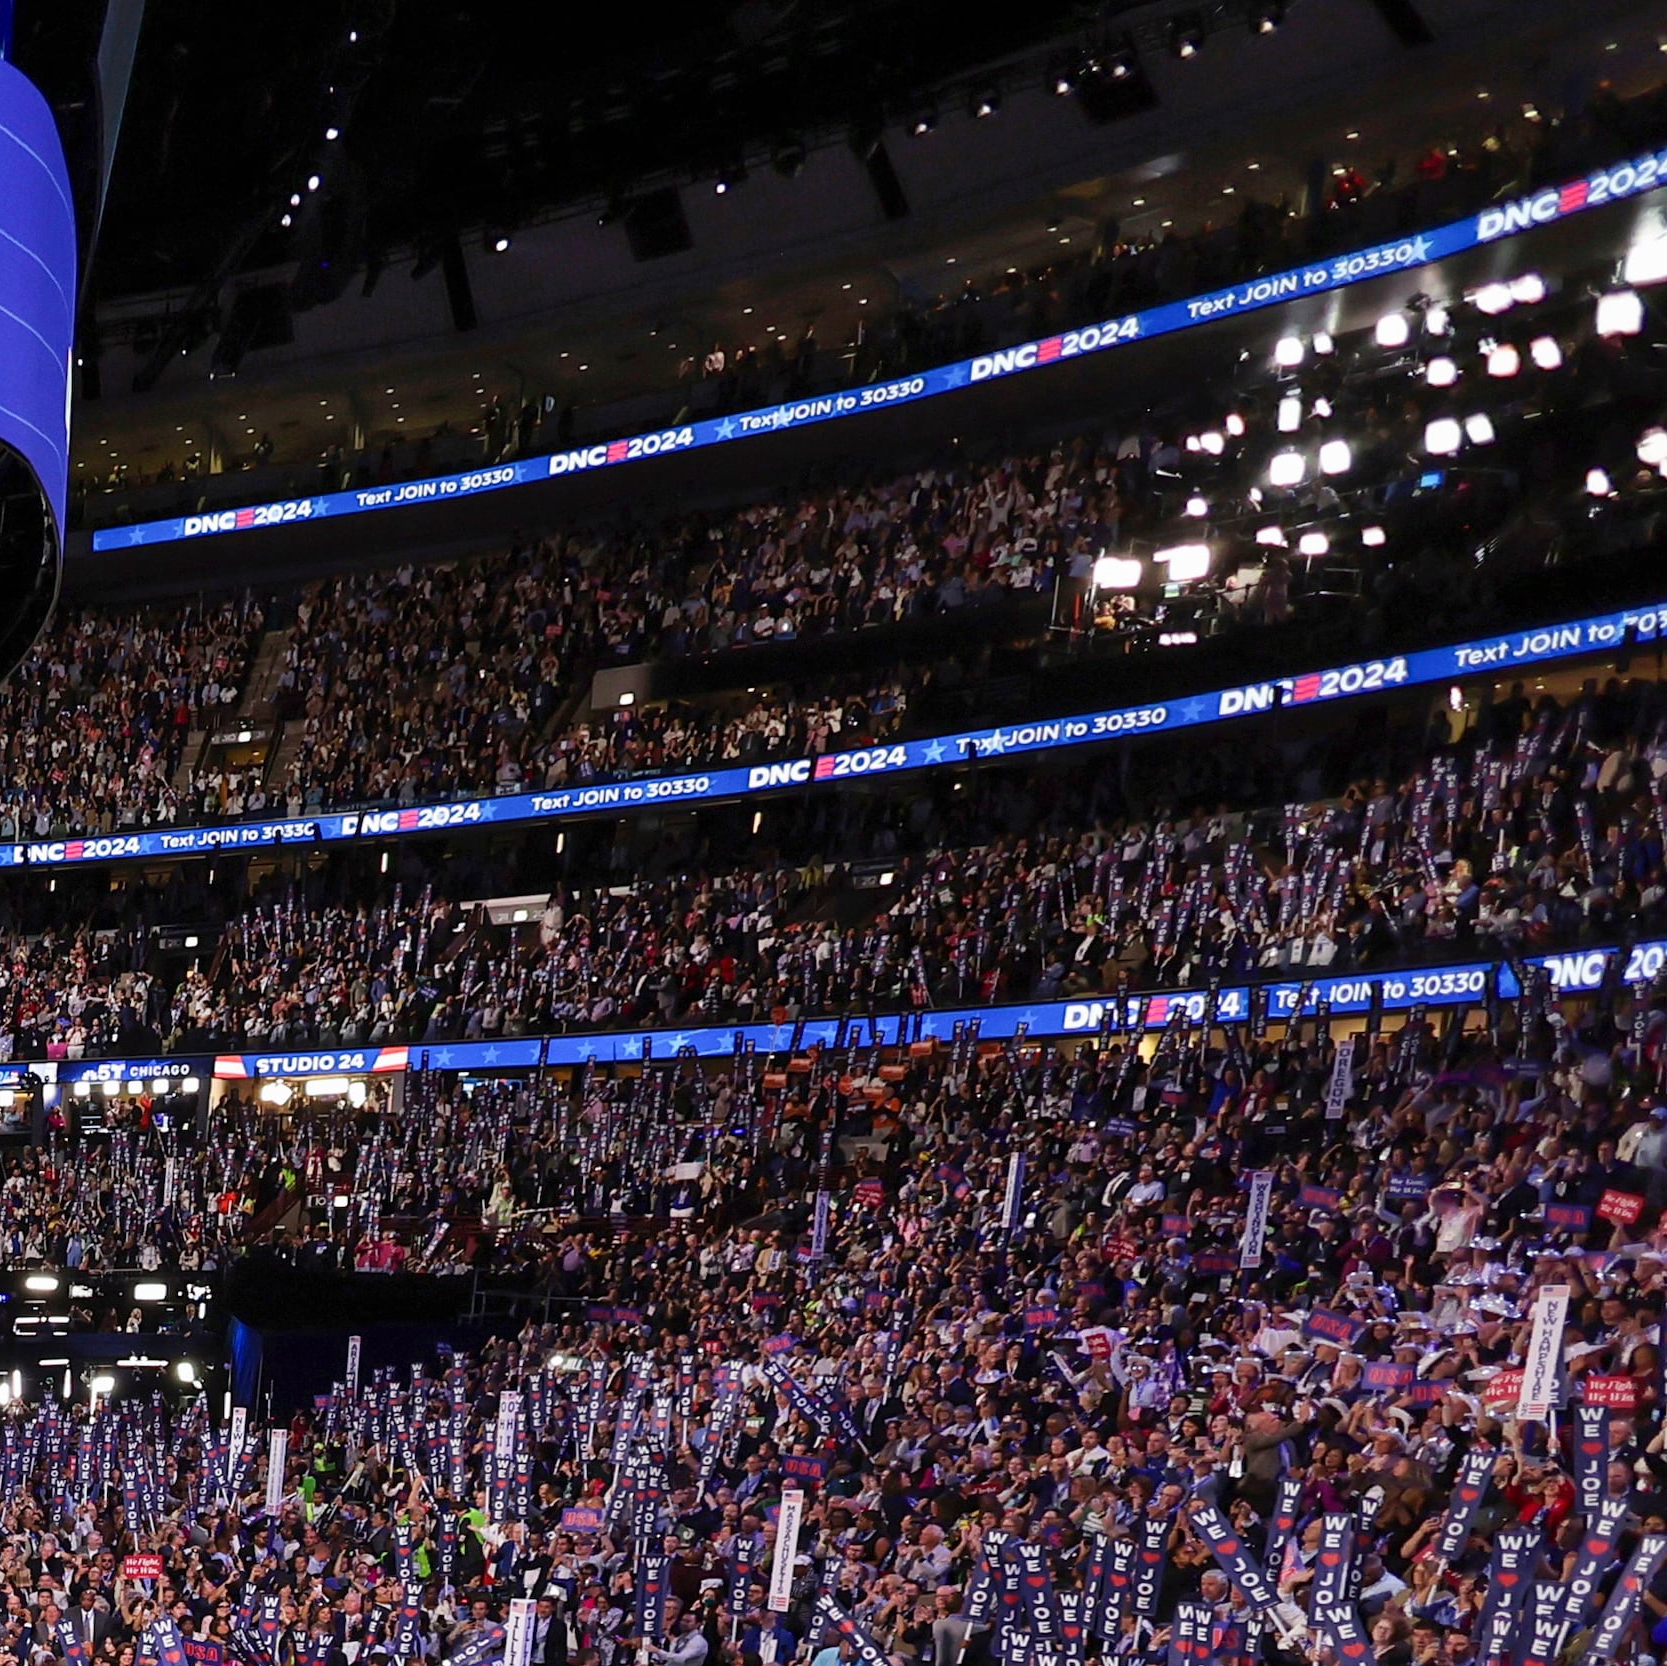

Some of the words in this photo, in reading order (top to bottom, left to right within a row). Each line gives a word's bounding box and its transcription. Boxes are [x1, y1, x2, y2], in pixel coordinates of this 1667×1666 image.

[1477, 192, 1560, 240] DNC
[1187, 293, 1235, 318] Text
[1239, 275, 1298, 305] JOIN
[1303, 270, 1328, 287] to
[1331, 243, 1410, 280] 30330
[970, 344, 1038, 381] DNC
[1060, 317, 1139, 356] 2024
[549, 445, 607, 475] DNC
[626, 427, 694, 459] 2024
[356, 490, 392, 506] Text
[394, 482, 437, 501] JOIN
[439, 481, 458, 494] to
[460, 467, 514, 491] 30330
[184, 511, 236, 536] DNC
[253, 500, 312, 525] 2024
[748, 759, 811, 789] DNC
[832, 745, 907, 776] 2024
[531, 794, 570, 811] Text
[572, 787, 620, 807] JOIN
[623, 787, 643, 800] to
[646, 777, 709, 800] 30330
[1409, 971, 1485, 997] 30330
[129, 1064, 190, 1078] CHICAGO
[255, 1054, 335, 1074] STUDIO
[337, 1052, 366, 1069] 24
[1330, 1048, 1351, 1107] OREGON
[1247, 1183, 1267, 1255] WASHINGTON
[1543, 1301, 1559, 1325] NEW
[1532, 1326, 1553, 1401] HAMPSHIRE
[1579, 1407, 1605, 1438] WE
[1581, 1460, 1601, 1507] JOE
